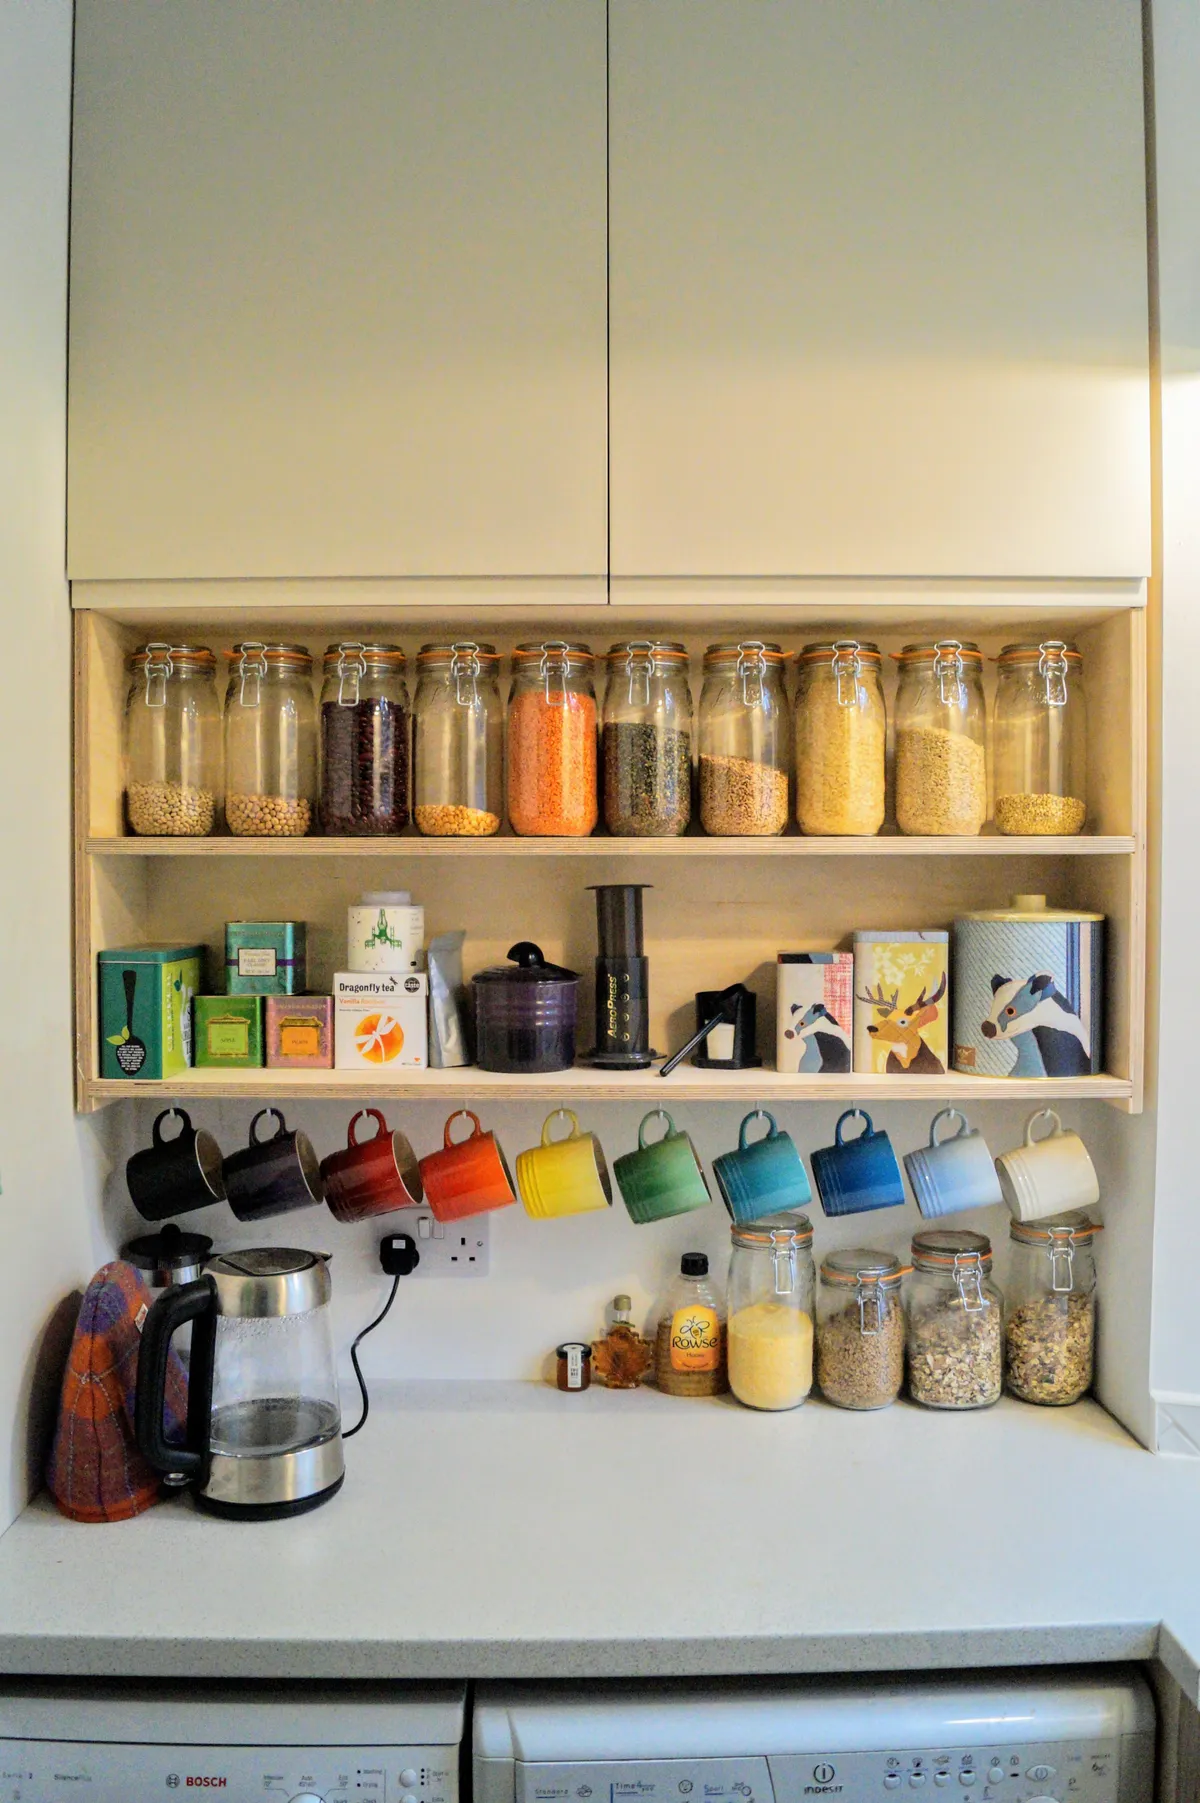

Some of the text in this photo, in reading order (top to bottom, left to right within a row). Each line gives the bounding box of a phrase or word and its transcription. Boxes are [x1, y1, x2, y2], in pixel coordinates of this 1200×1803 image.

[339, 982, 380, 993] Dragonfly
[381, 984, 395, 992] tea
[672, 1336, 718, 1350] Rowse
[186, 1776, 227, 1787] BOSCH
